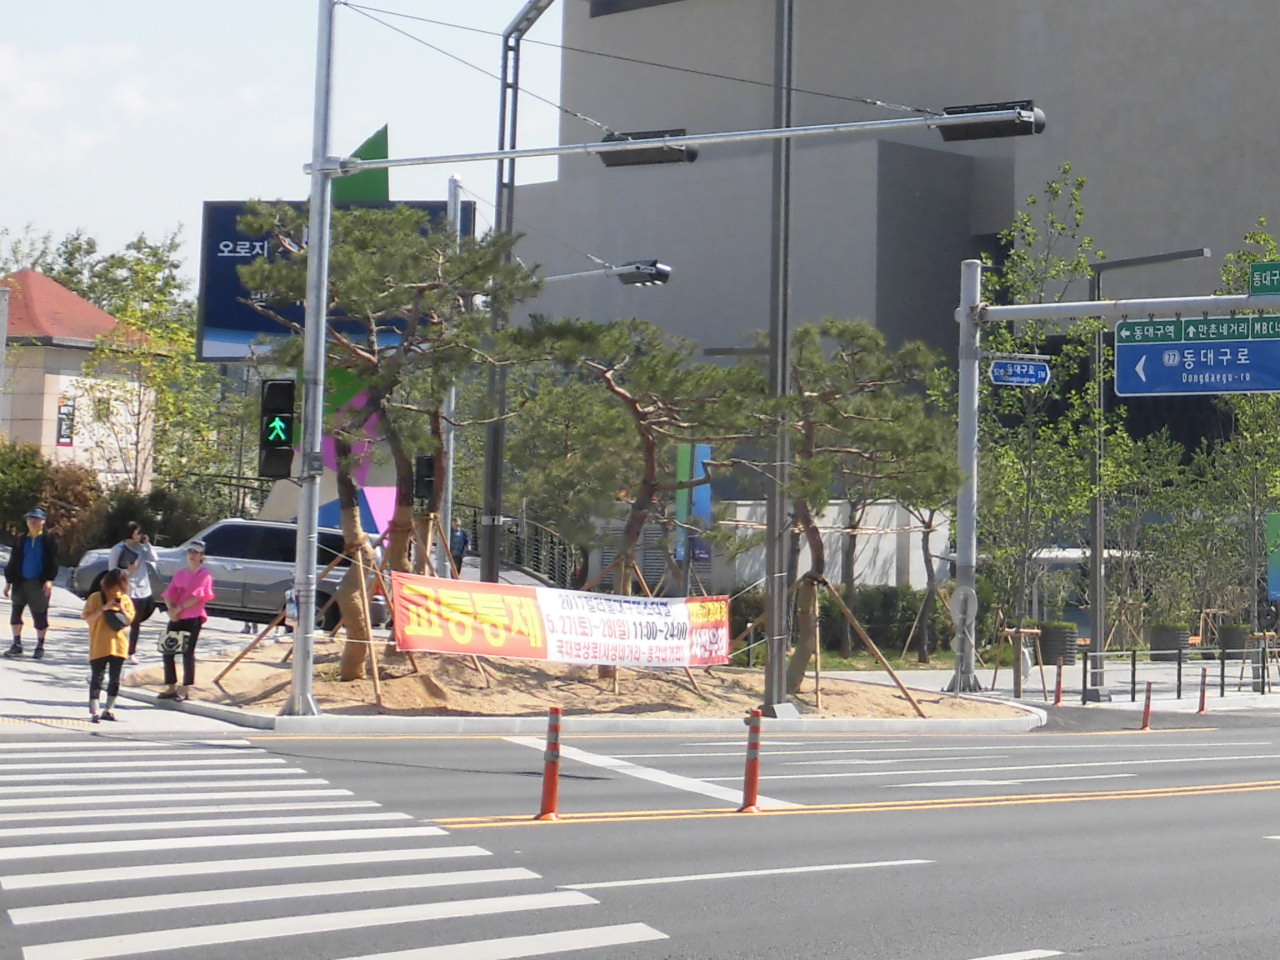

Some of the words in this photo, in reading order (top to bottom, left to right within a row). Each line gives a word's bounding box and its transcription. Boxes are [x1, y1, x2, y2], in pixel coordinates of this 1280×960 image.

[217, 241, 268, 257] 오로지
[1133, 324, 1175, 340] 동대구역
[1198, 322, 1248, 338] 만촌네거리
[1182, 348, 1250, 370] 동대구로
[1007, 364, 1035, 376] 동대구로
[1182, 371, 1250, 384] Dongdaegu-ro
[402, 584, 543, 647] 교통통제
[633, 620, 688, 641] 11:00~24:00
